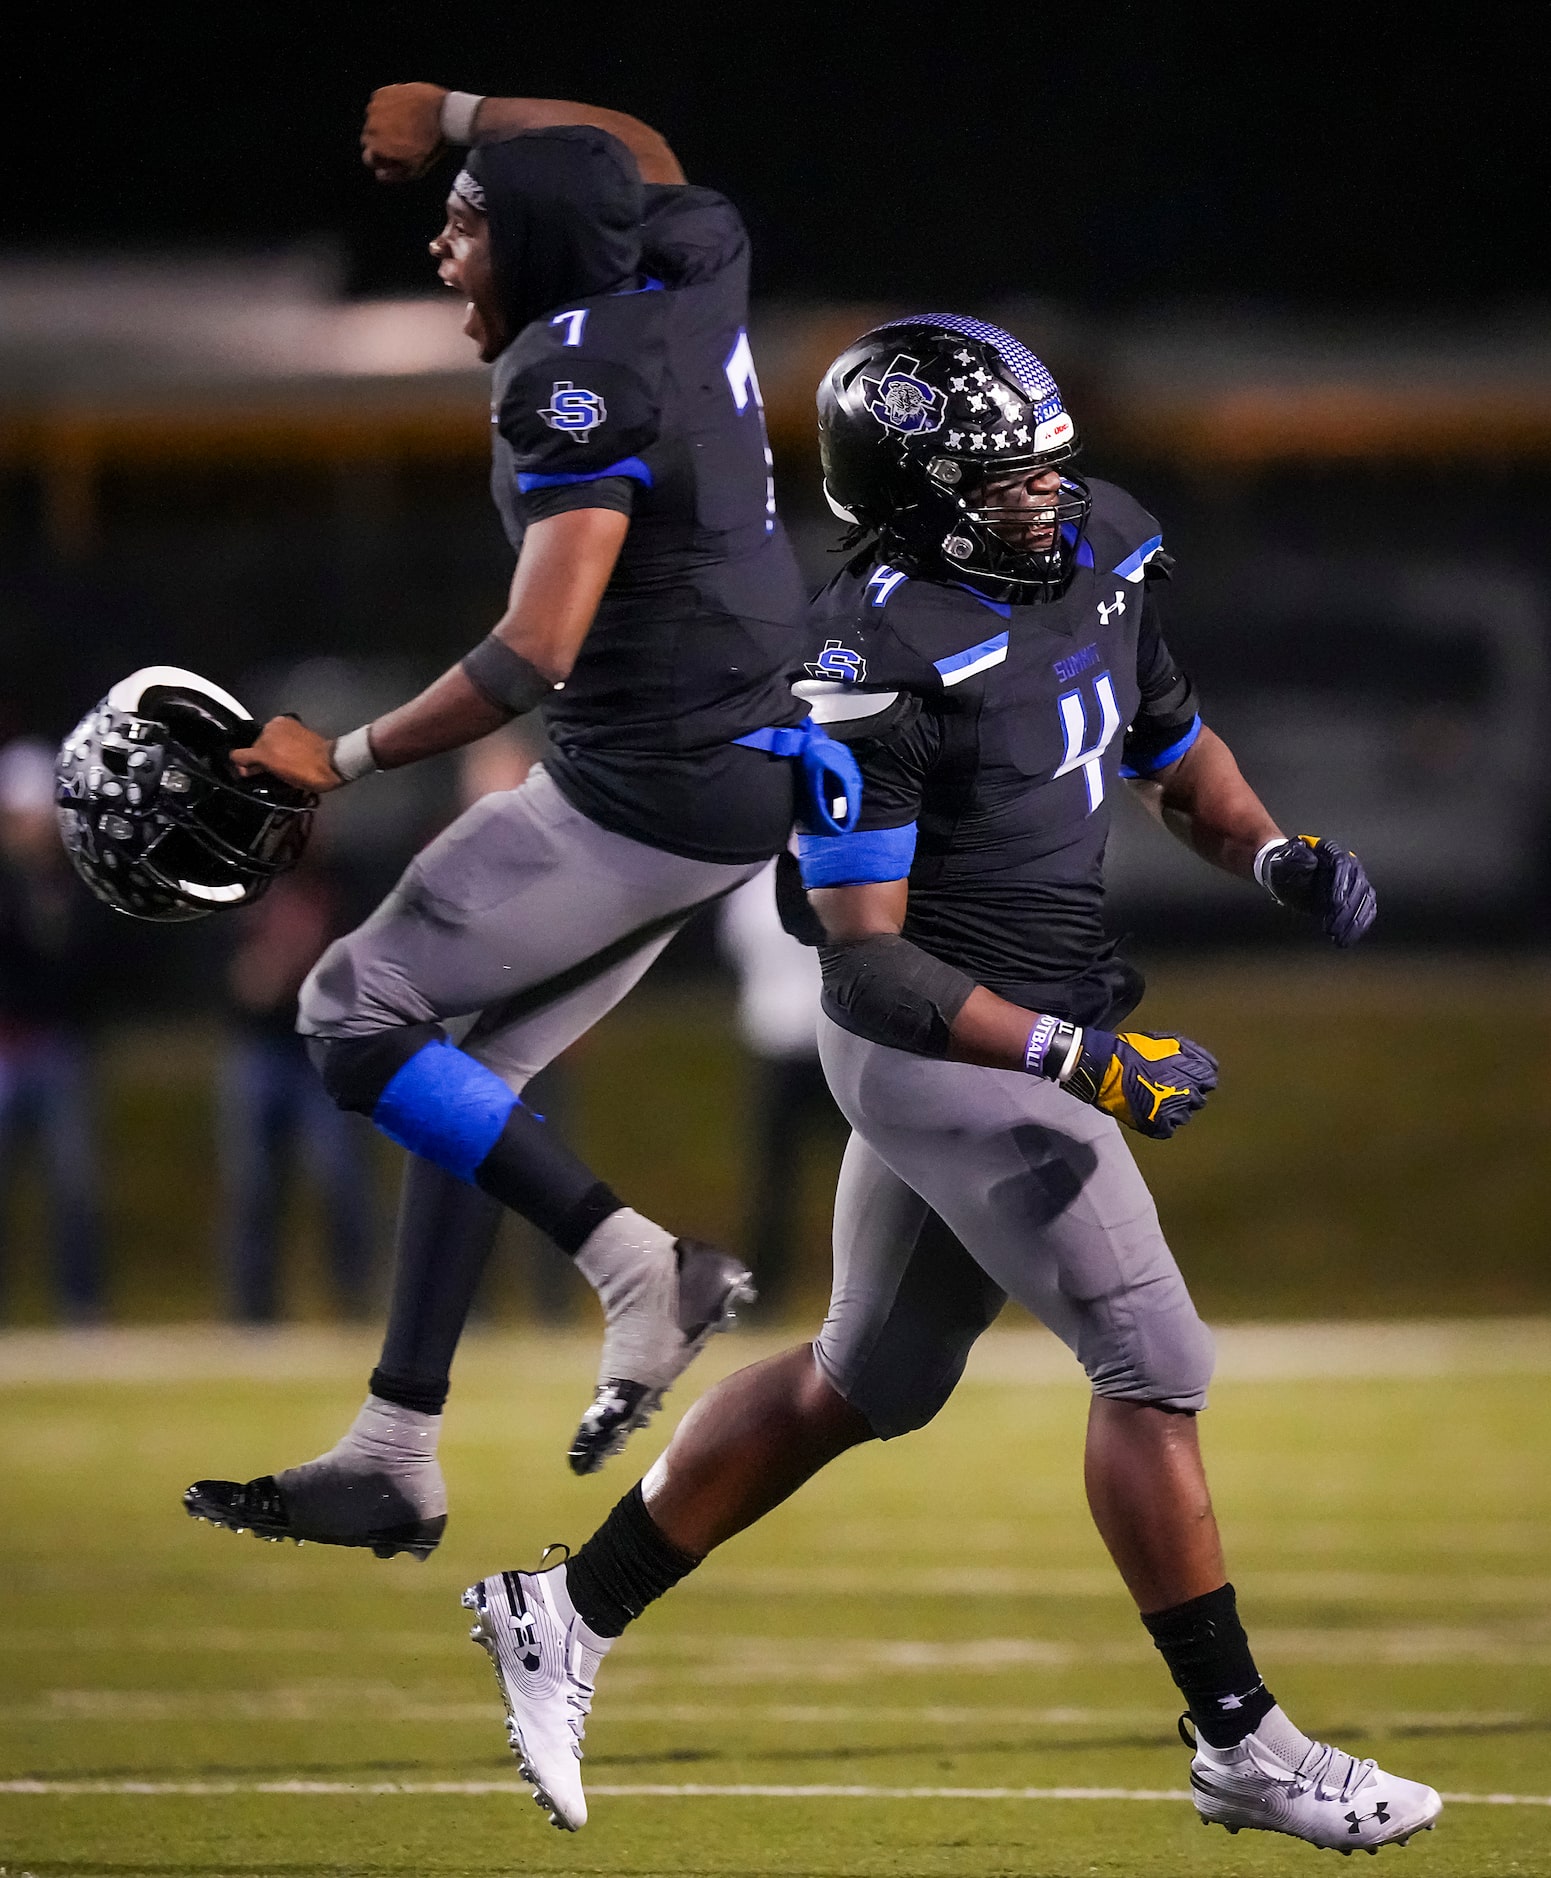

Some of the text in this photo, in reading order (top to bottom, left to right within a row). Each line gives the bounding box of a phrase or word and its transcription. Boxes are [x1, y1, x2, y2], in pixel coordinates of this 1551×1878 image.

[550, 308, 590, 347] 7
[550, 388, 602, 432] S
[869, 564, 909, 608] 4
[1052, 669, 1123, 818] 4
